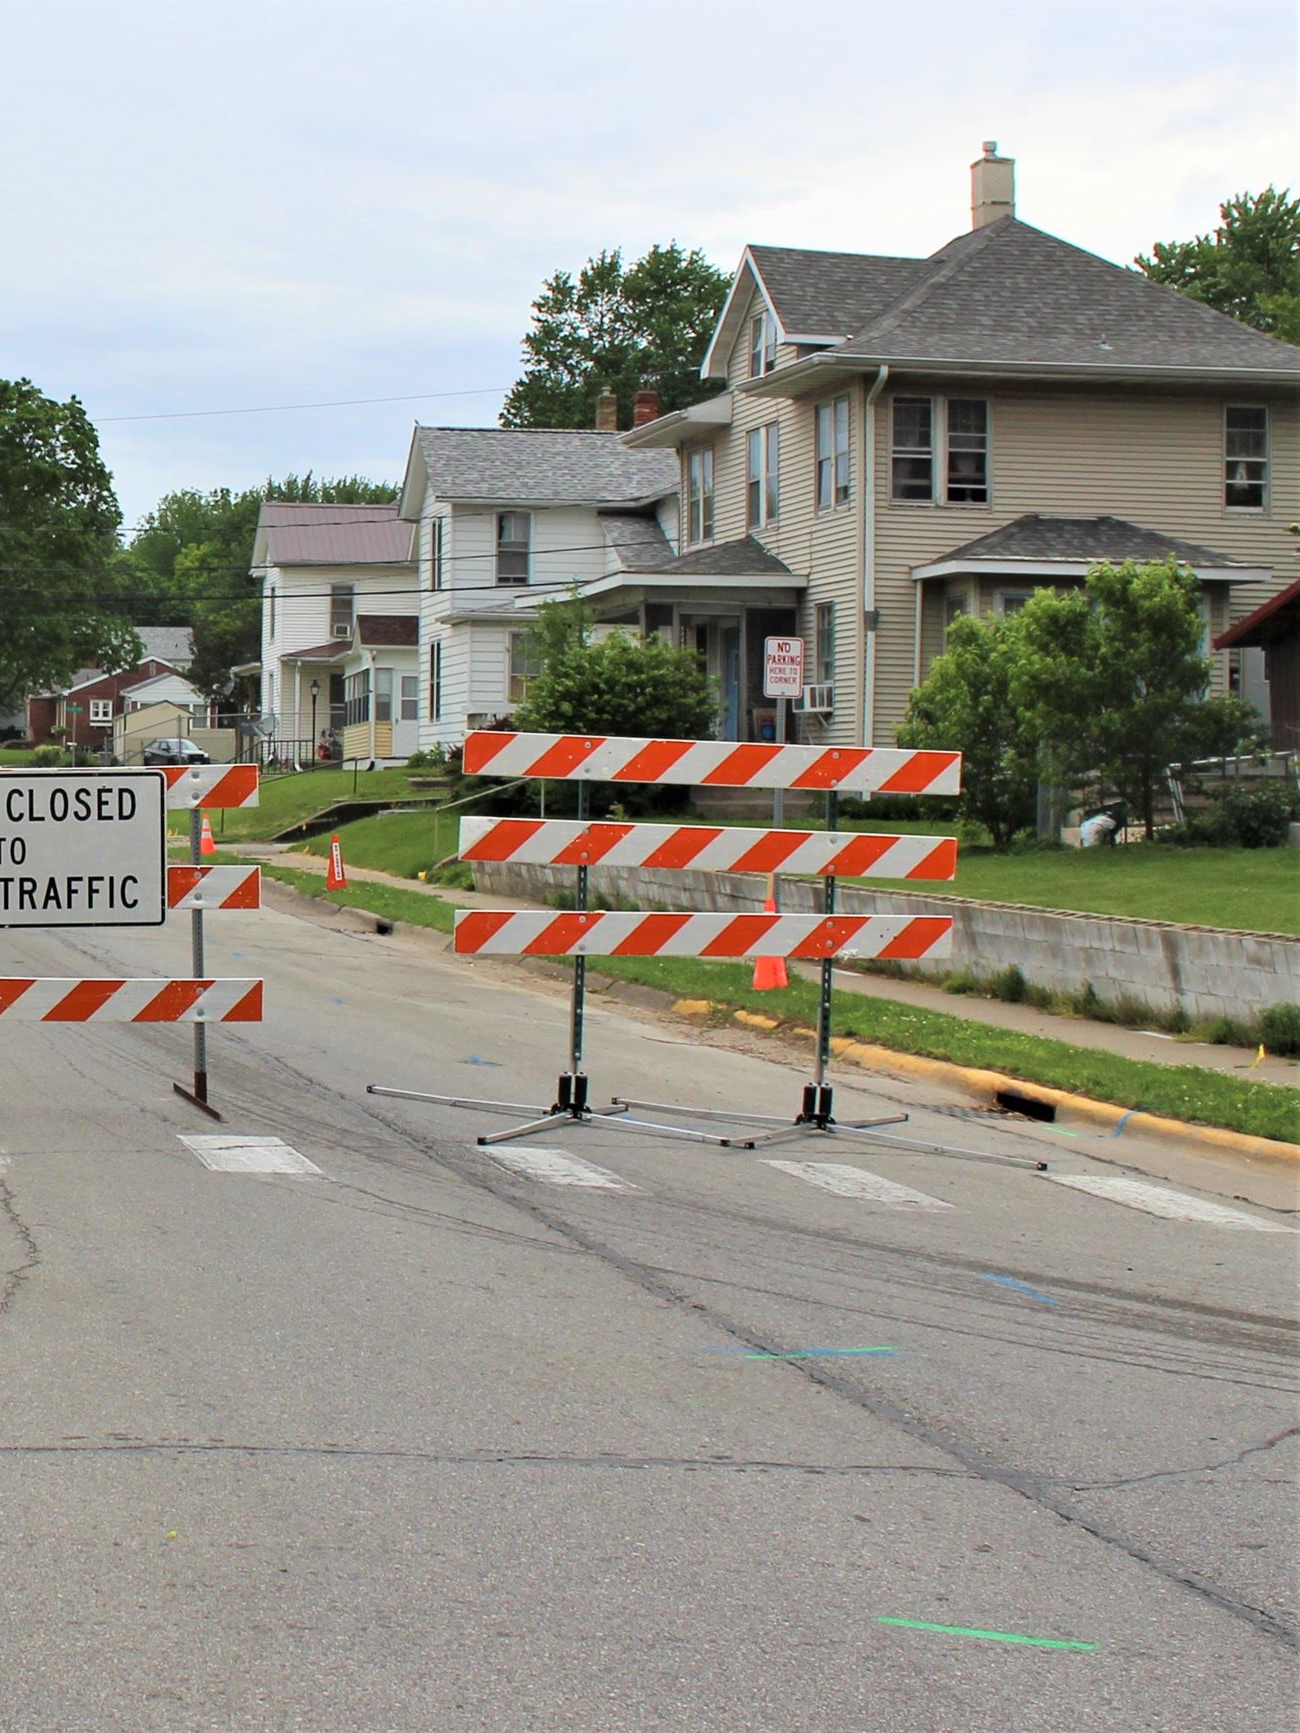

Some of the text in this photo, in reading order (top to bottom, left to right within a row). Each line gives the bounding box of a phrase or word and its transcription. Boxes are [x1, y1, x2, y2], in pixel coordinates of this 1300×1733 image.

[778, 642, 791, 653] NO
[767, 655, 800, 666] PARKING
[769, 667, 797, 675] HERE TO
[770, 676, 797, 684] CORNER
[6, 787, 138, 823] CLOSED
